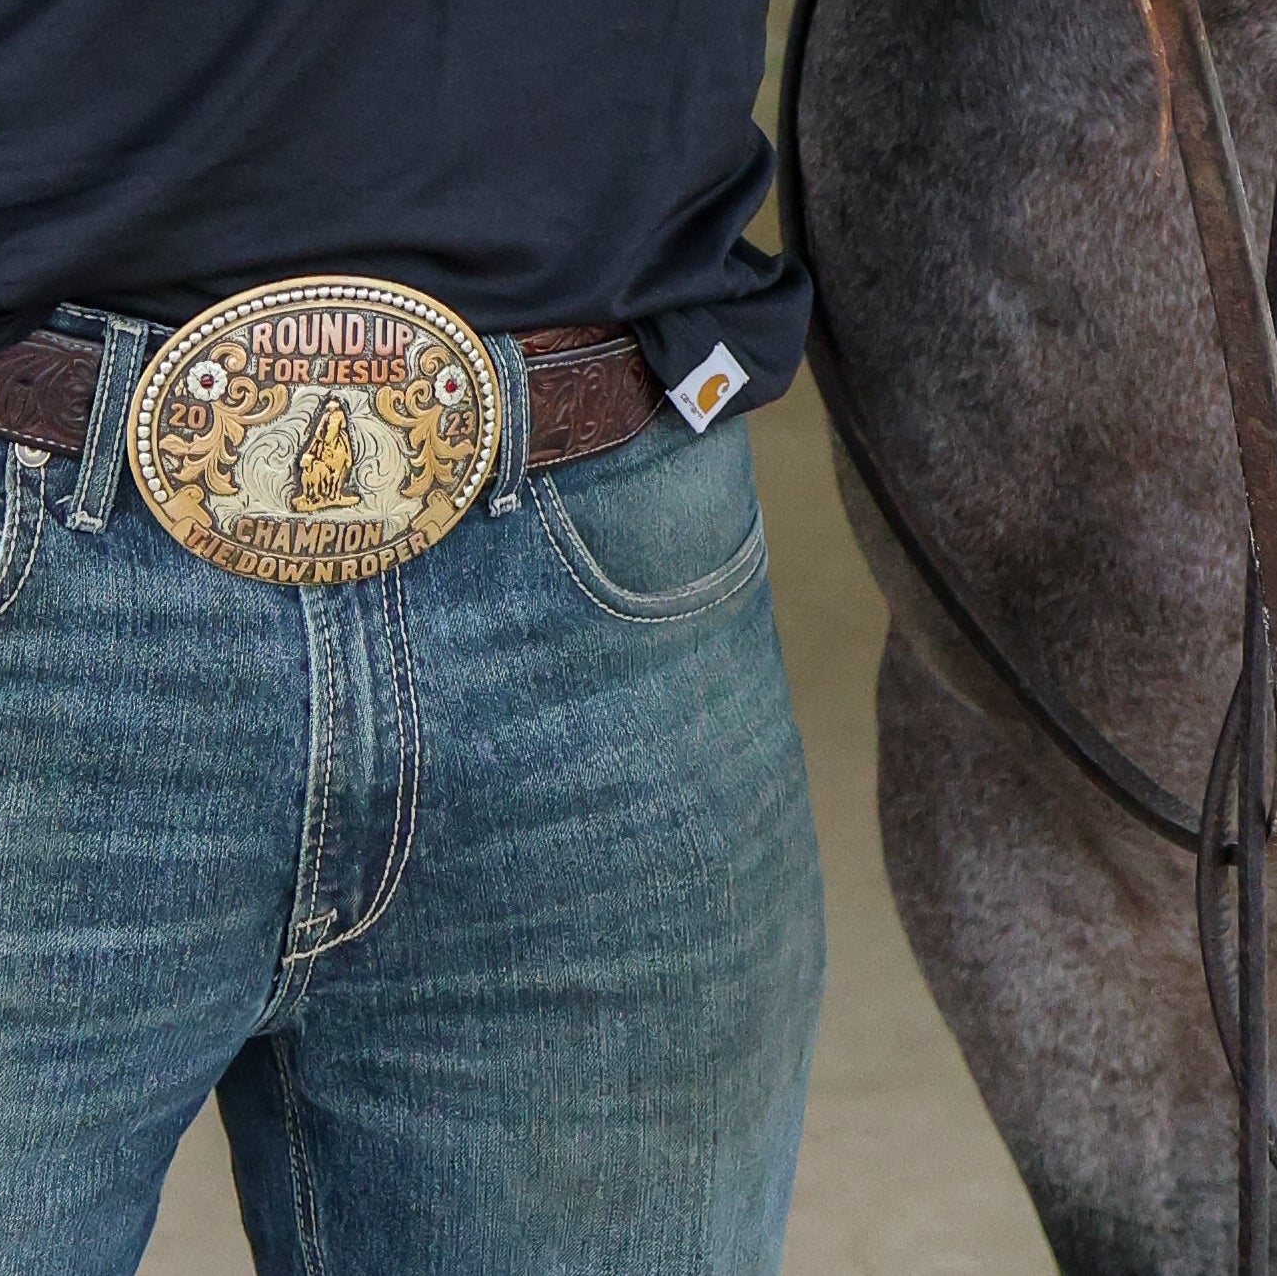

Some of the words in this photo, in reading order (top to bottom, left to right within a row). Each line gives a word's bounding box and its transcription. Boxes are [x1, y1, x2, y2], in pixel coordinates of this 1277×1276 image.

[251, 312, 369, 356] ROUND
[370, 324, 415, 358] UP
[257, 357, 315, 383] FOR
[319, 358, 407, 385] JESUS
[169, 402, 206, 430] 20
[446, 411, 475, 439] 23
[235, 517, 383, 555] CHAMPION
[185, 522, 233, 568] TIE
[234, 549, 334, 584] DOWN
[341, 530, 430, 581] ROPER
